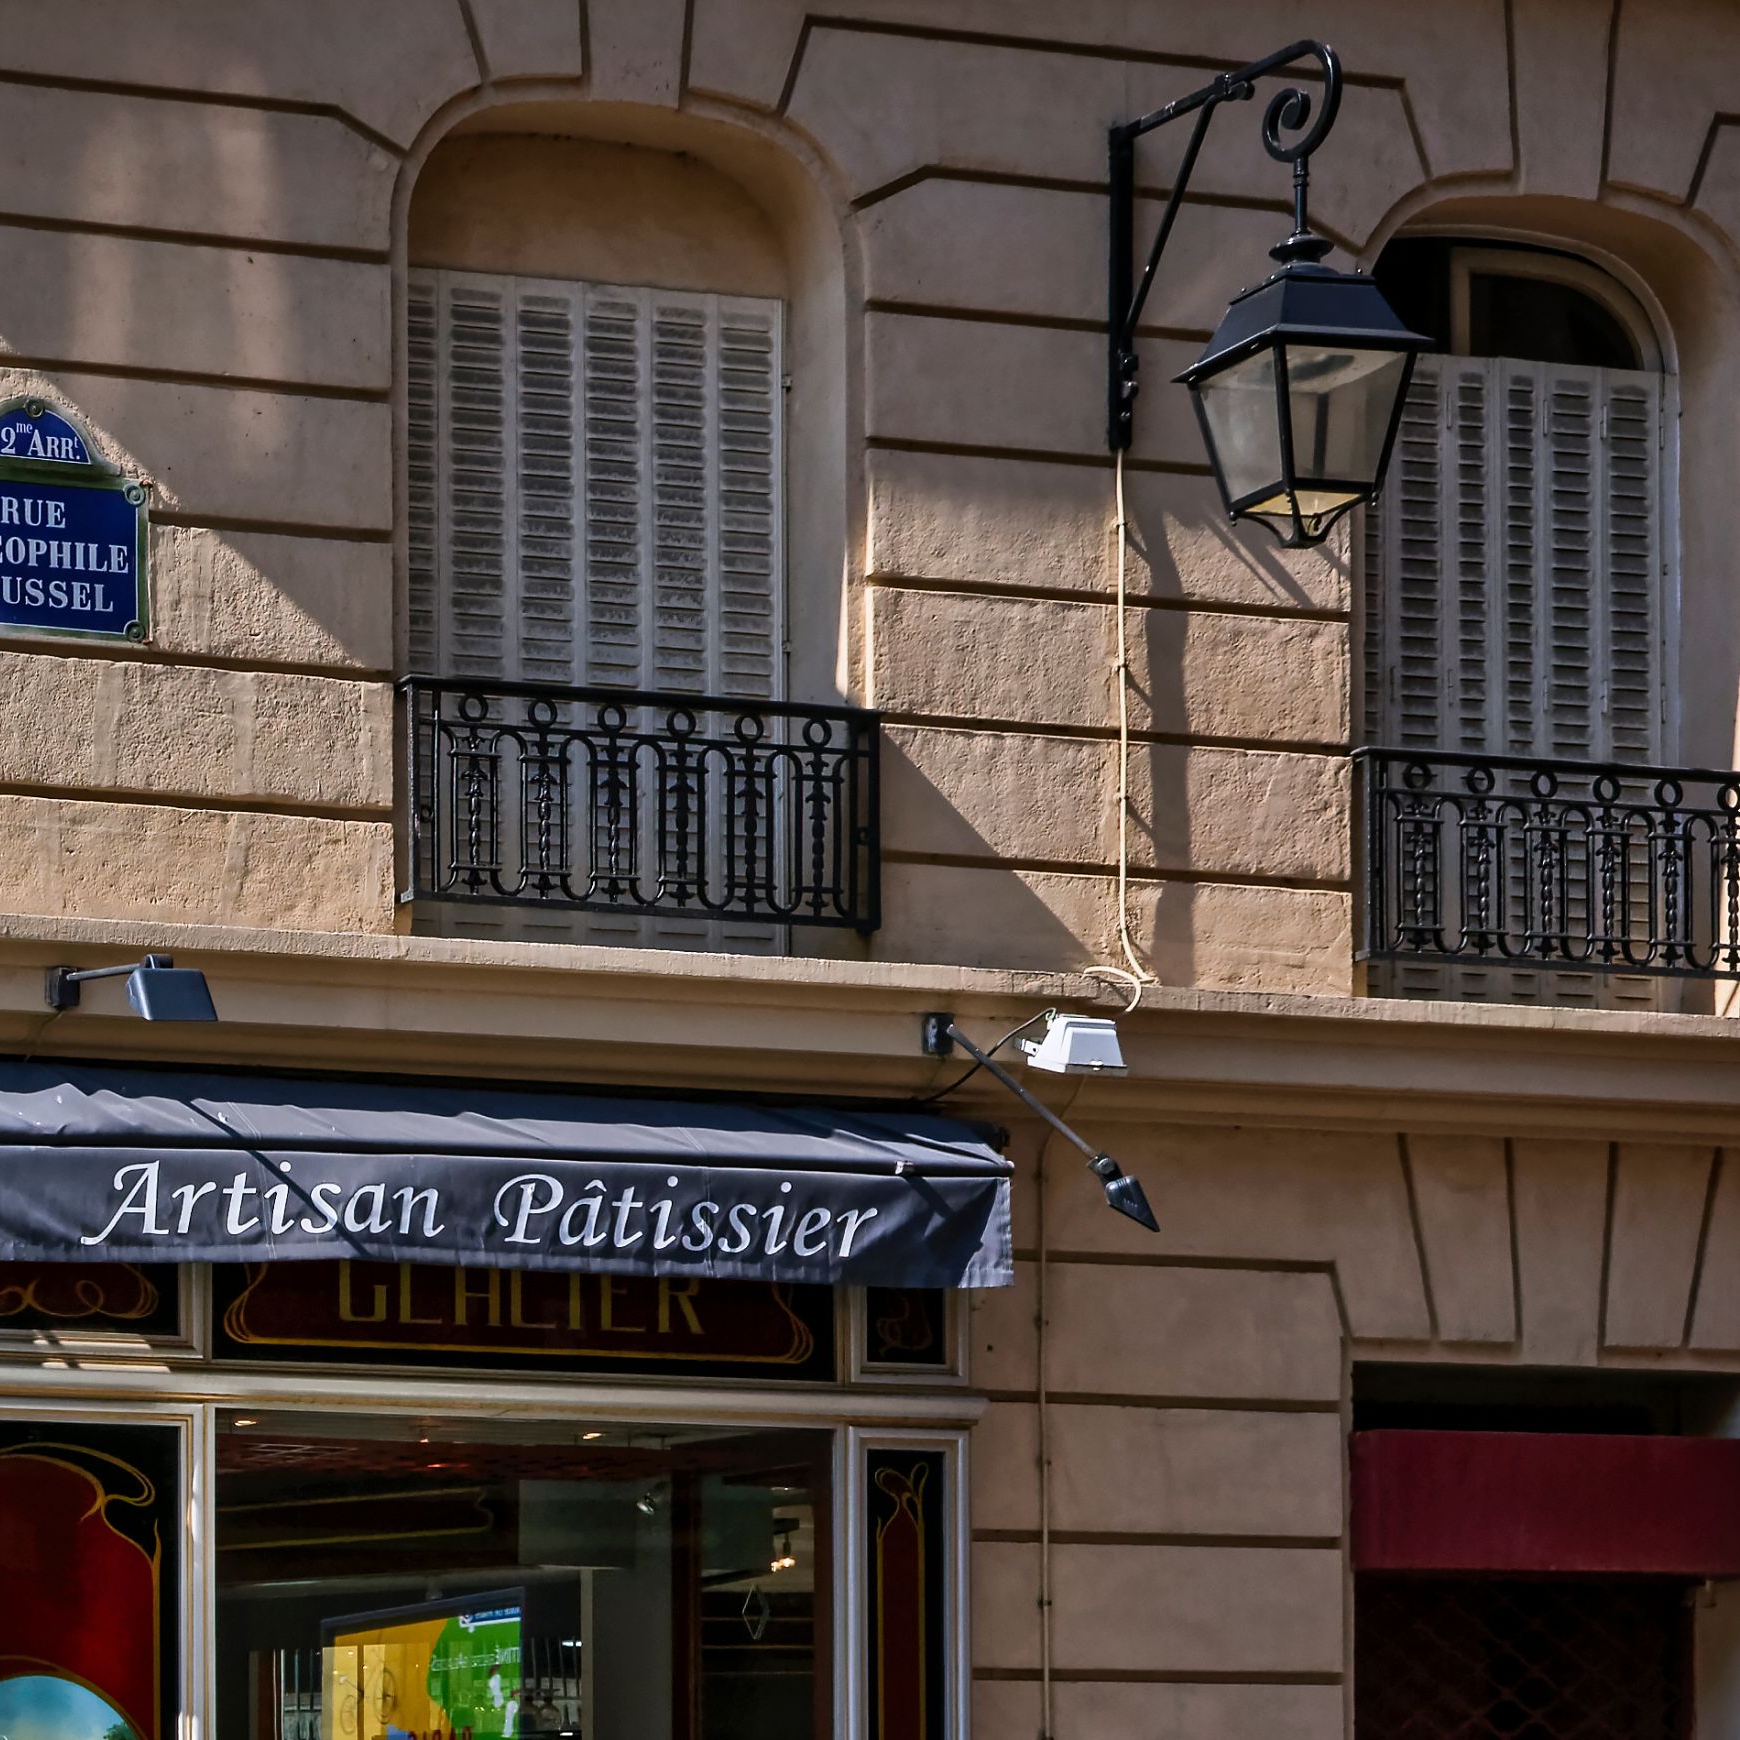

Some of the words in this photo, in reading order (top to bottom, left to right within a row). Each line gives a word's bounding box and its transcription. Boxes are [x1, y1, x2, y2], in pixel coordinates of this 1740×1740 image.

[0, 496, 66, 528] RUE
[80, 1160, 445, 1245] Artisan
[494, 1173, 878, 1258] Pâtissier
